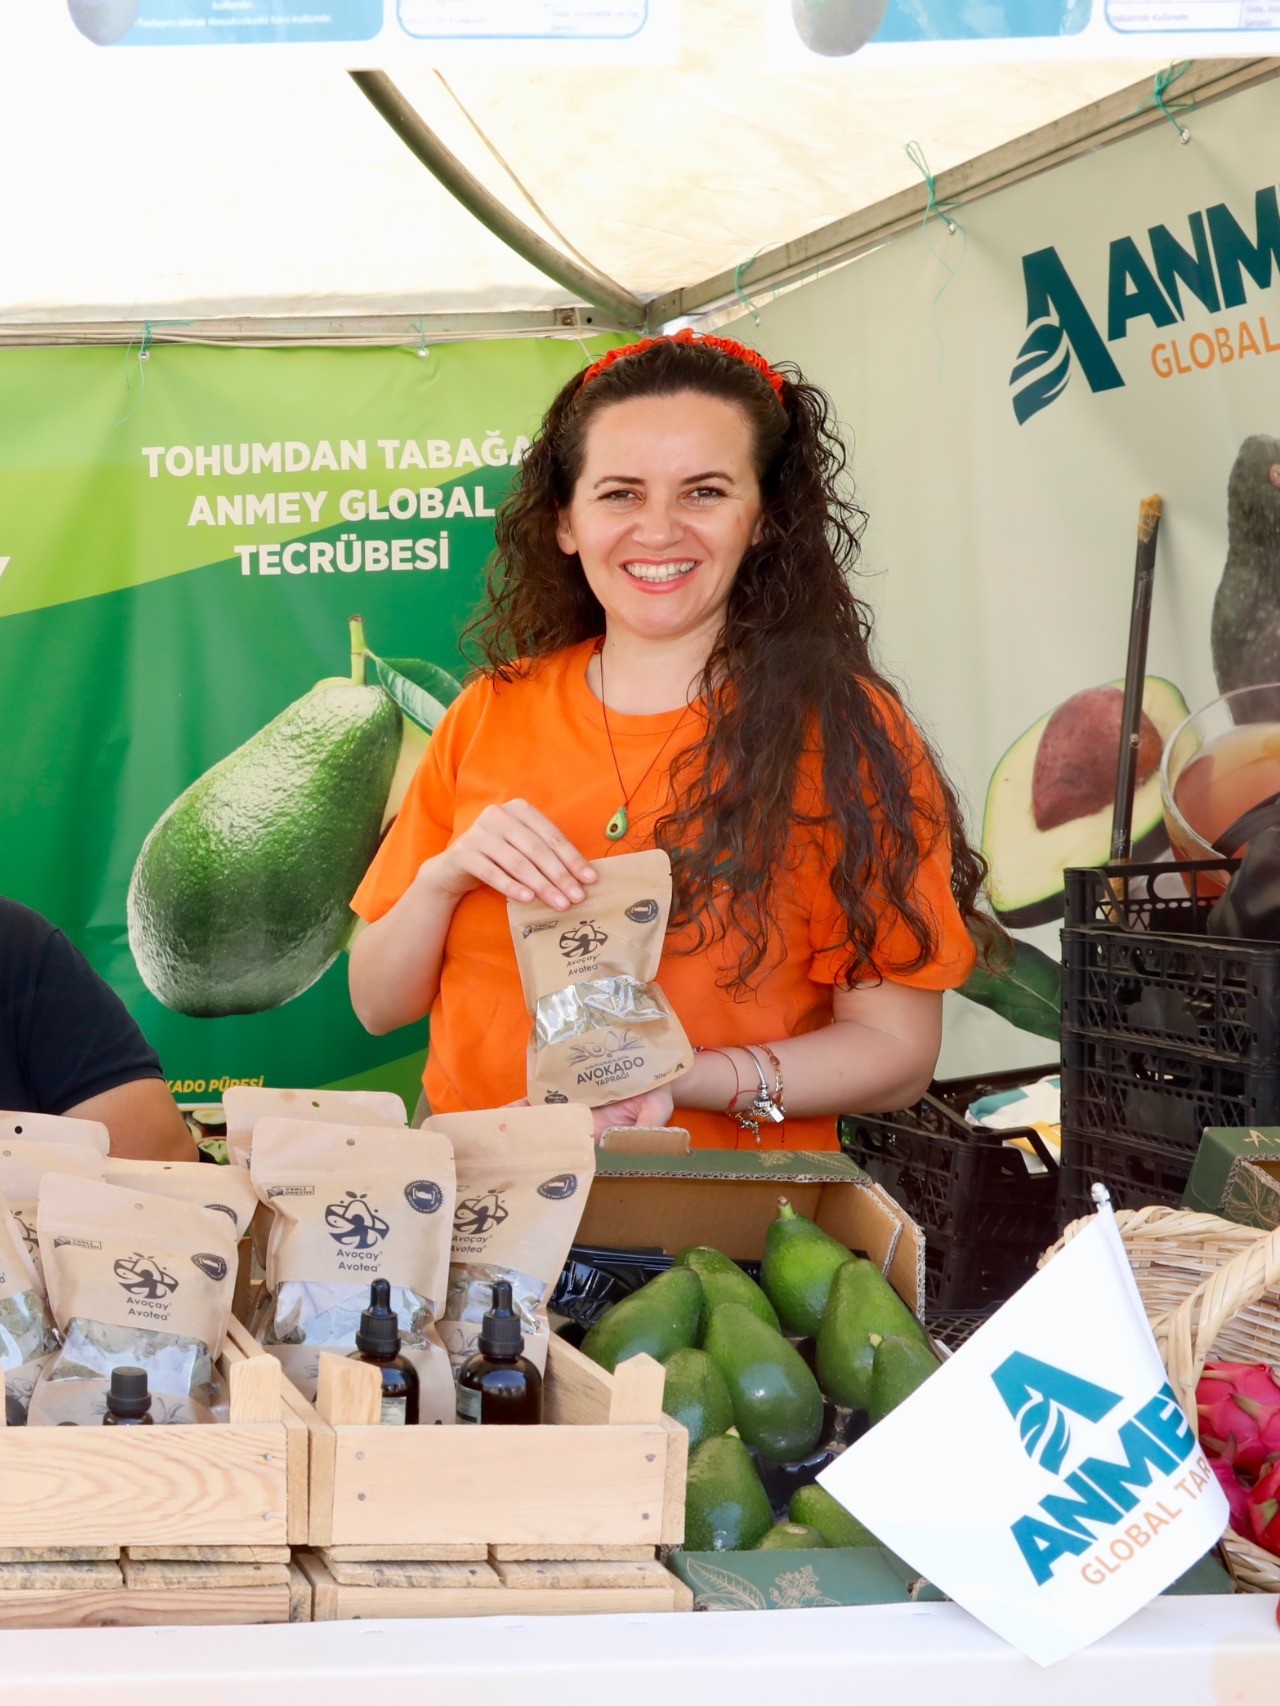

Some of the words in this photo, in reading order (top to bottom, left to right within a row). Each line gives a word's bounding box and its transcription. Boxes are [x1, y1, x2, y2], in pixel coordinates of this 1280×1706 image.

[1151, 316, 1280, 379] GLOBAL
[141, 439, 367, 478] TOHUMDAN
[187, 490, 328, 526] ANMEY
[339, 486, 495, 521] GLOBAL
[233, 530, 449, 576] TECRÜBESİ
[568, 963, 598, 977] Avotea
[577, 1056, 645, 1085] AVOKADO
[595, 1072, 630, 1087] YAPRAĞI
[336, 1248, 380, 1261] Avoçay
[338, 1261, 378, 1273] Avotea
[126, 1296, 170, 1311] Avoçay
[128, 1308, 168, 1321] Avotea
[1080, 1507, 1183, 1586] GLOBAL
